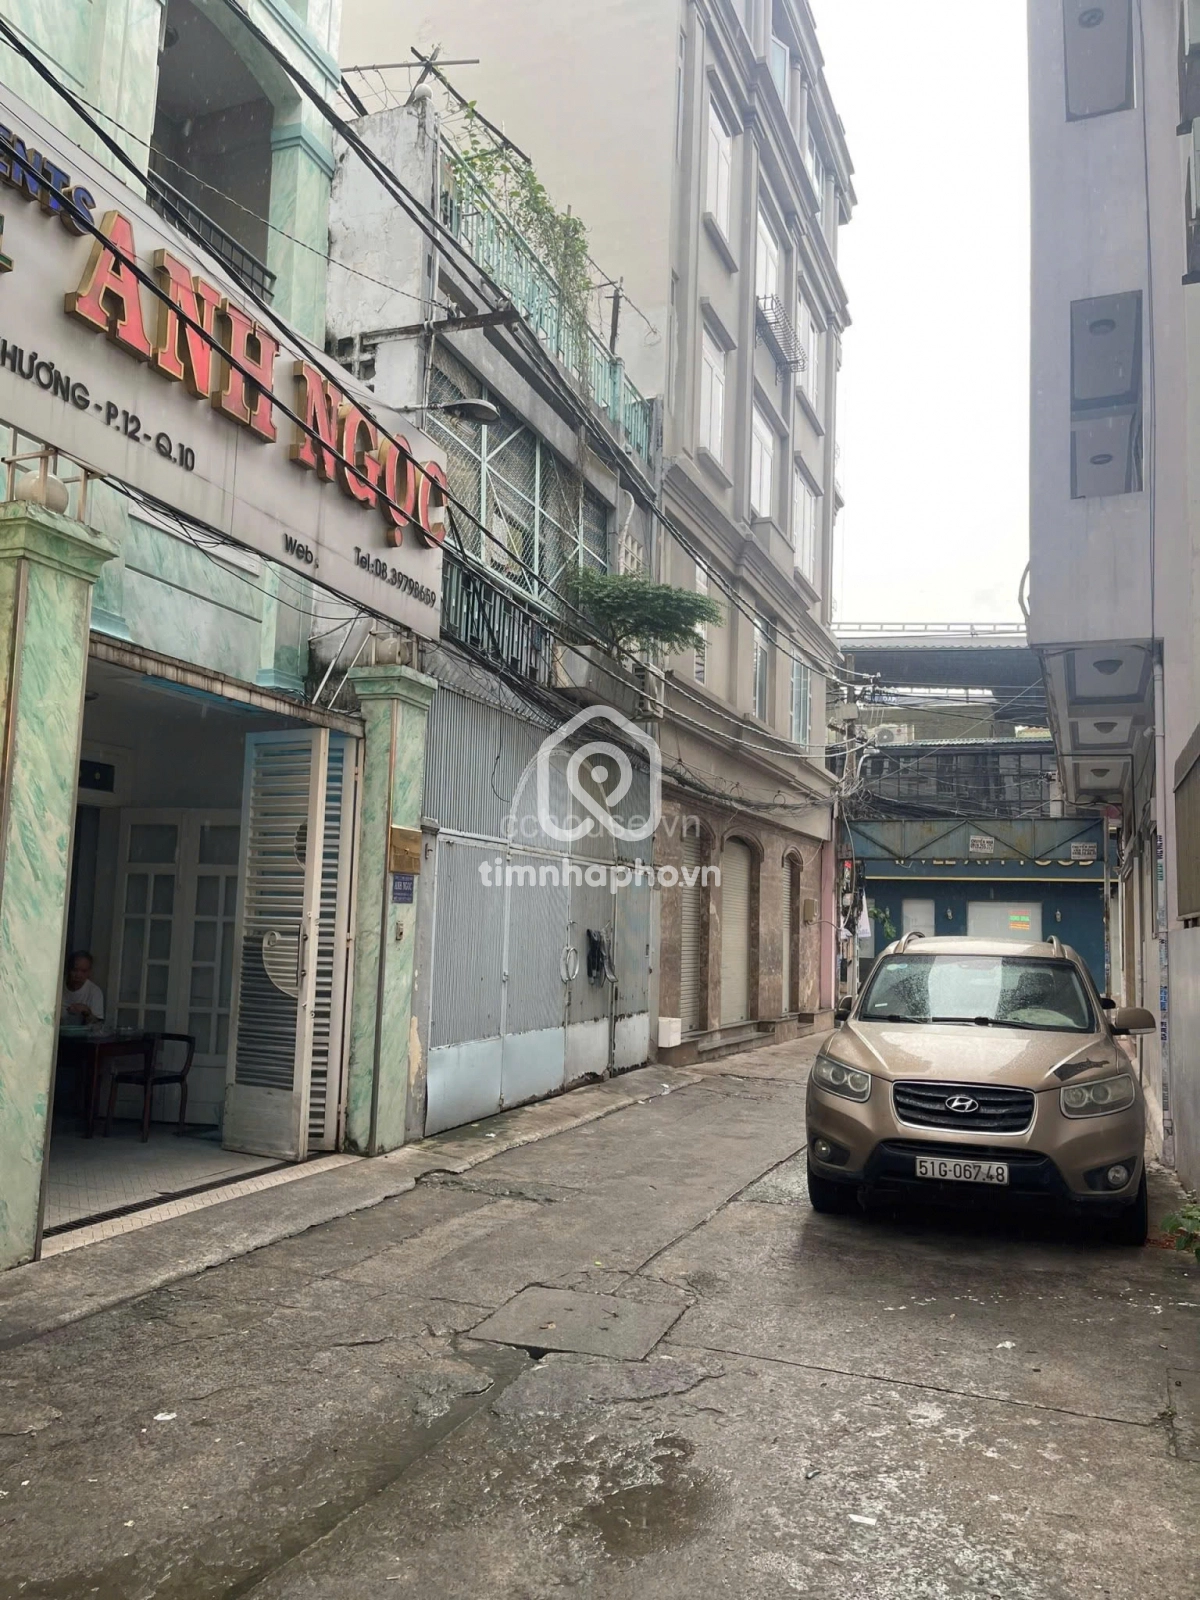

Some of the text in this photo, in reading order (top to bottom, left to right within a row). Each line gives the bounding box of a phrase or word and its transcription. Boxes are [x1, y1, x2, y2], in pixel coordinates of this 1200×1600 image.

[0, 336, 90, 410] HƯƠNG
[64, 210, 448, 549] ANH NGỌC
[919, 1160, 1005, 1183] 51G-067.48
